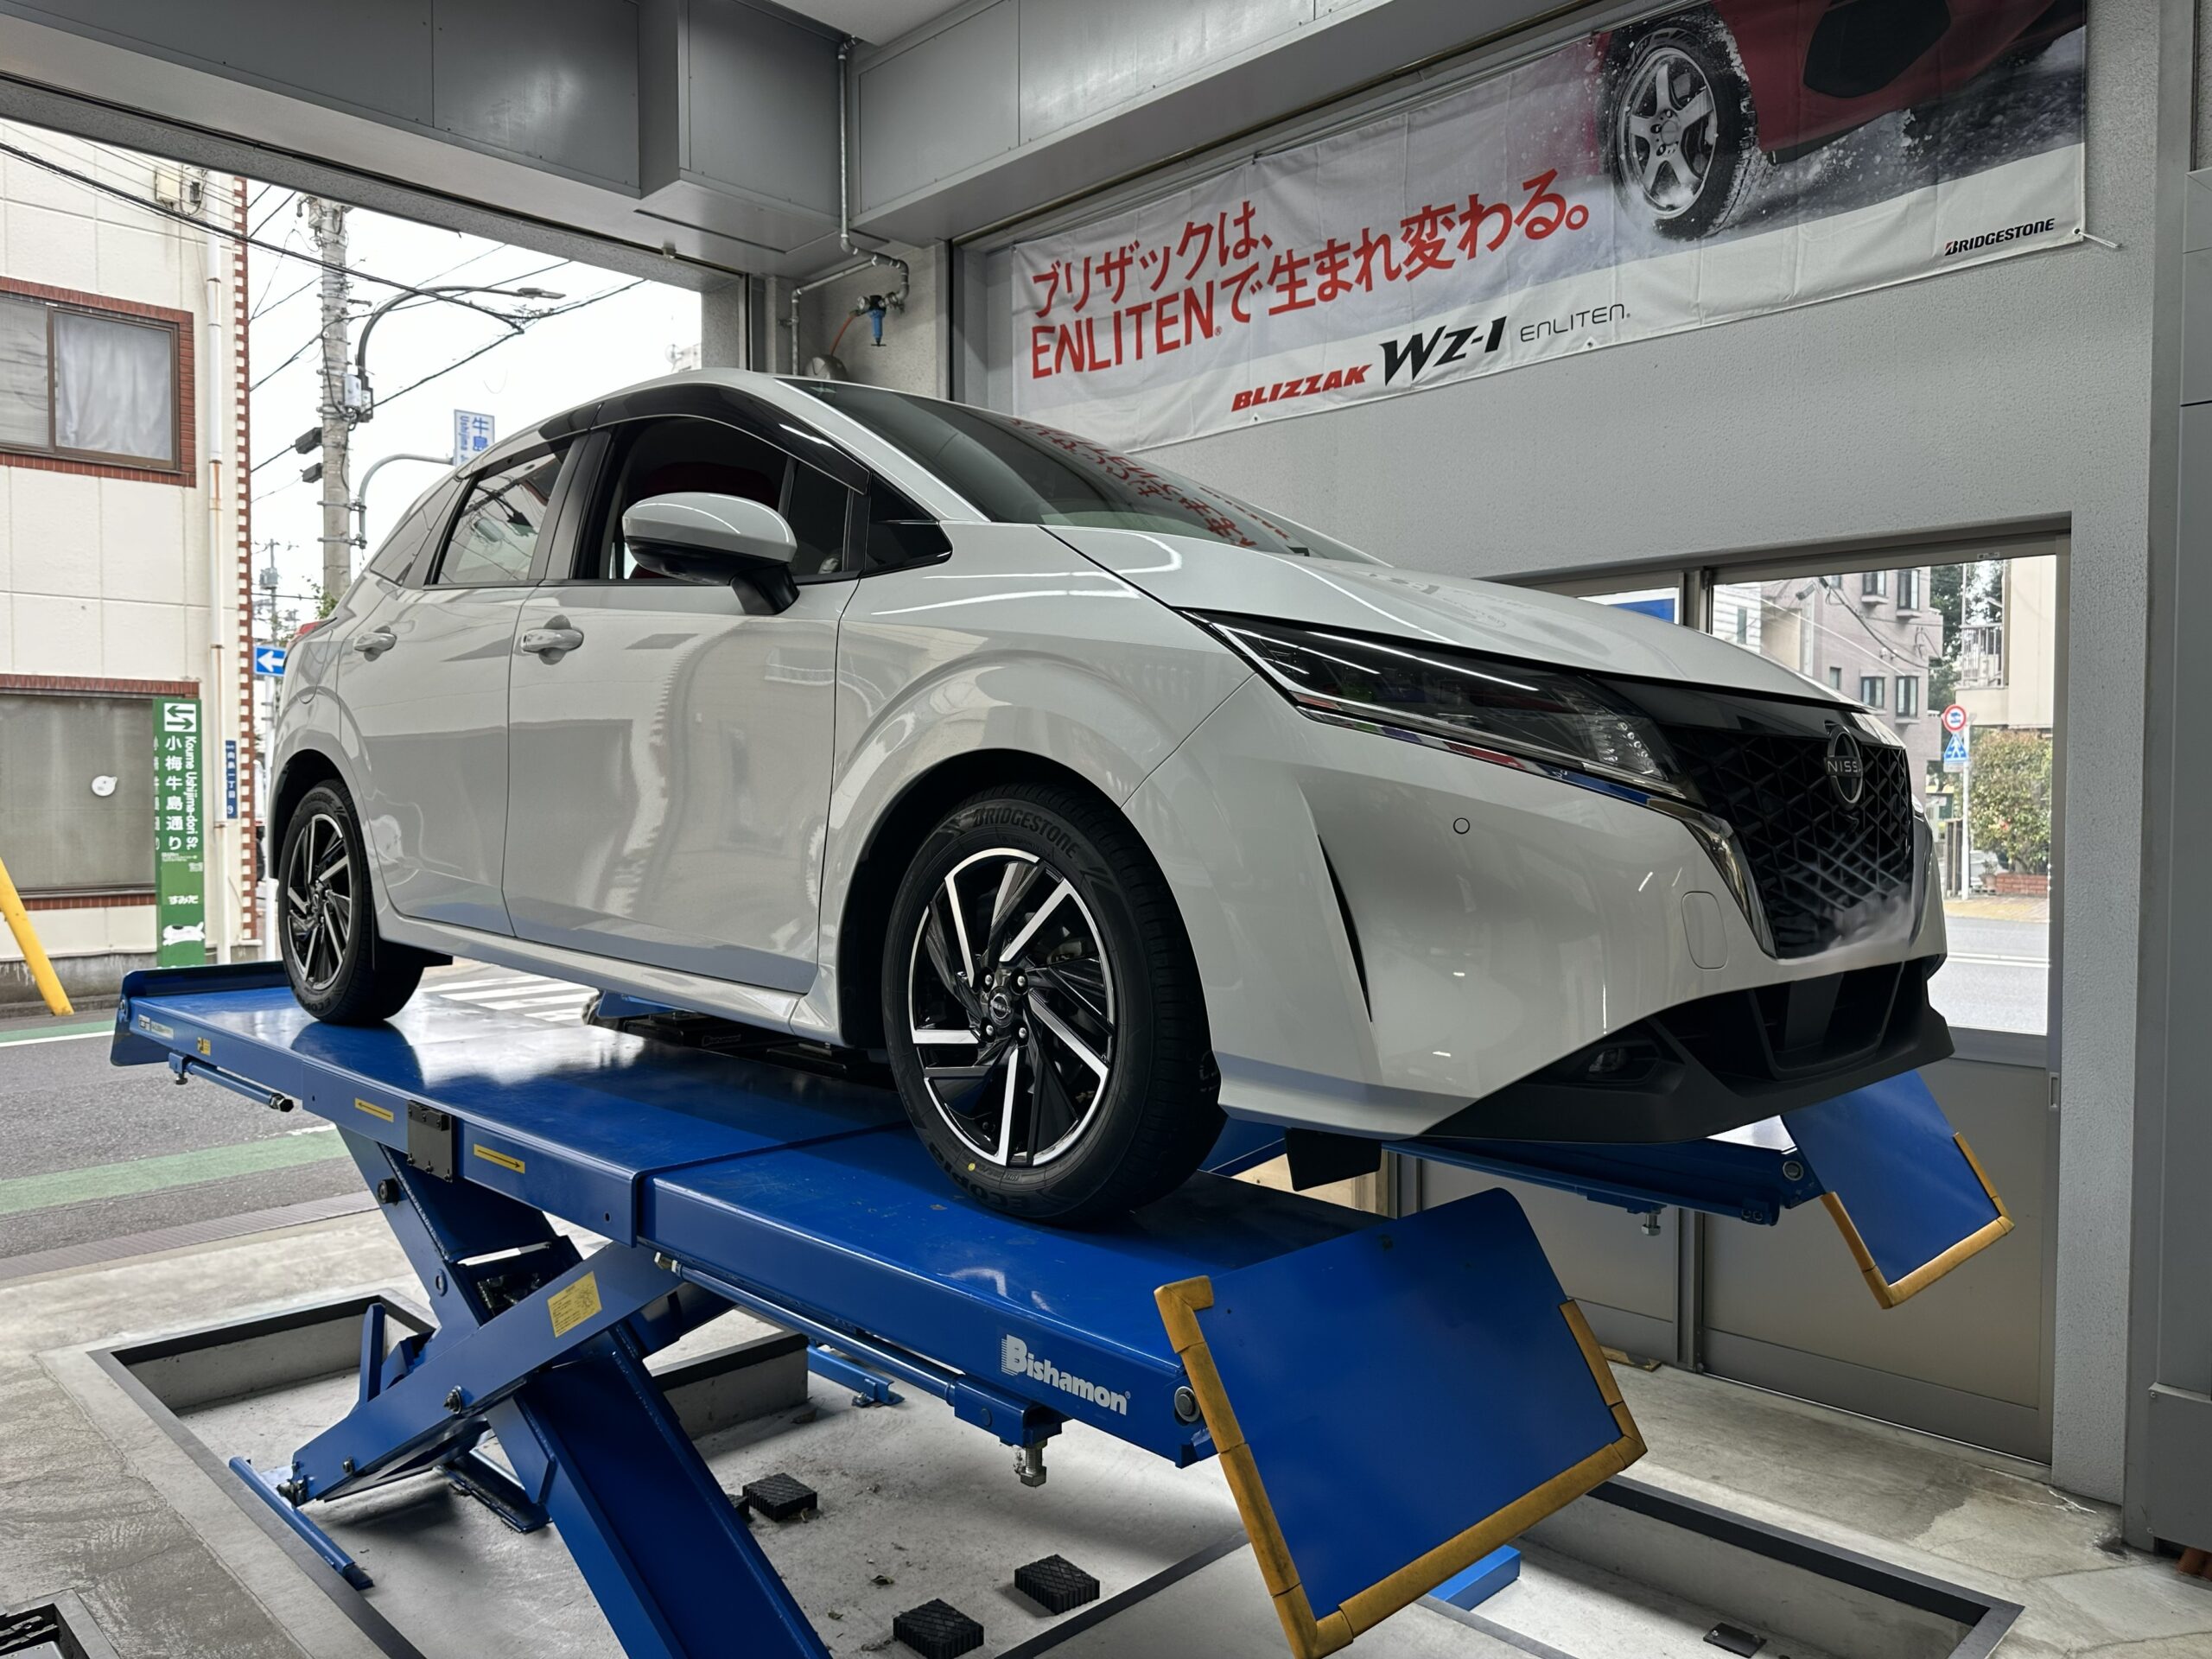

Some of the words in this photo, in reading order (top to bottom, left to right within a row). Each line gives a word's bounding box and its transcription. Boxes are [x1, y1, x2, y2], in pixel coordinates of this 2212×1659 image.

[1033, 200, 1273, 318] ブリザックは、
[1945, 218, 2055, 256] BRIDGESTONE
[1231, 364, 1372, 412] BLIZZAK
[1379, 315, 1507, 386] WZ-1
[184, 735, 198, 770] Koume
[1827, 760, 1862, 773] NISS
[165, 734, 183, 851] 小梅牛島通り
[183, 772, 199, 835] Ushijima-dori
[973, 807, 1081, 859] BRIDGESTONE
[1001, 1333, 1128, 1416] Bishamon
